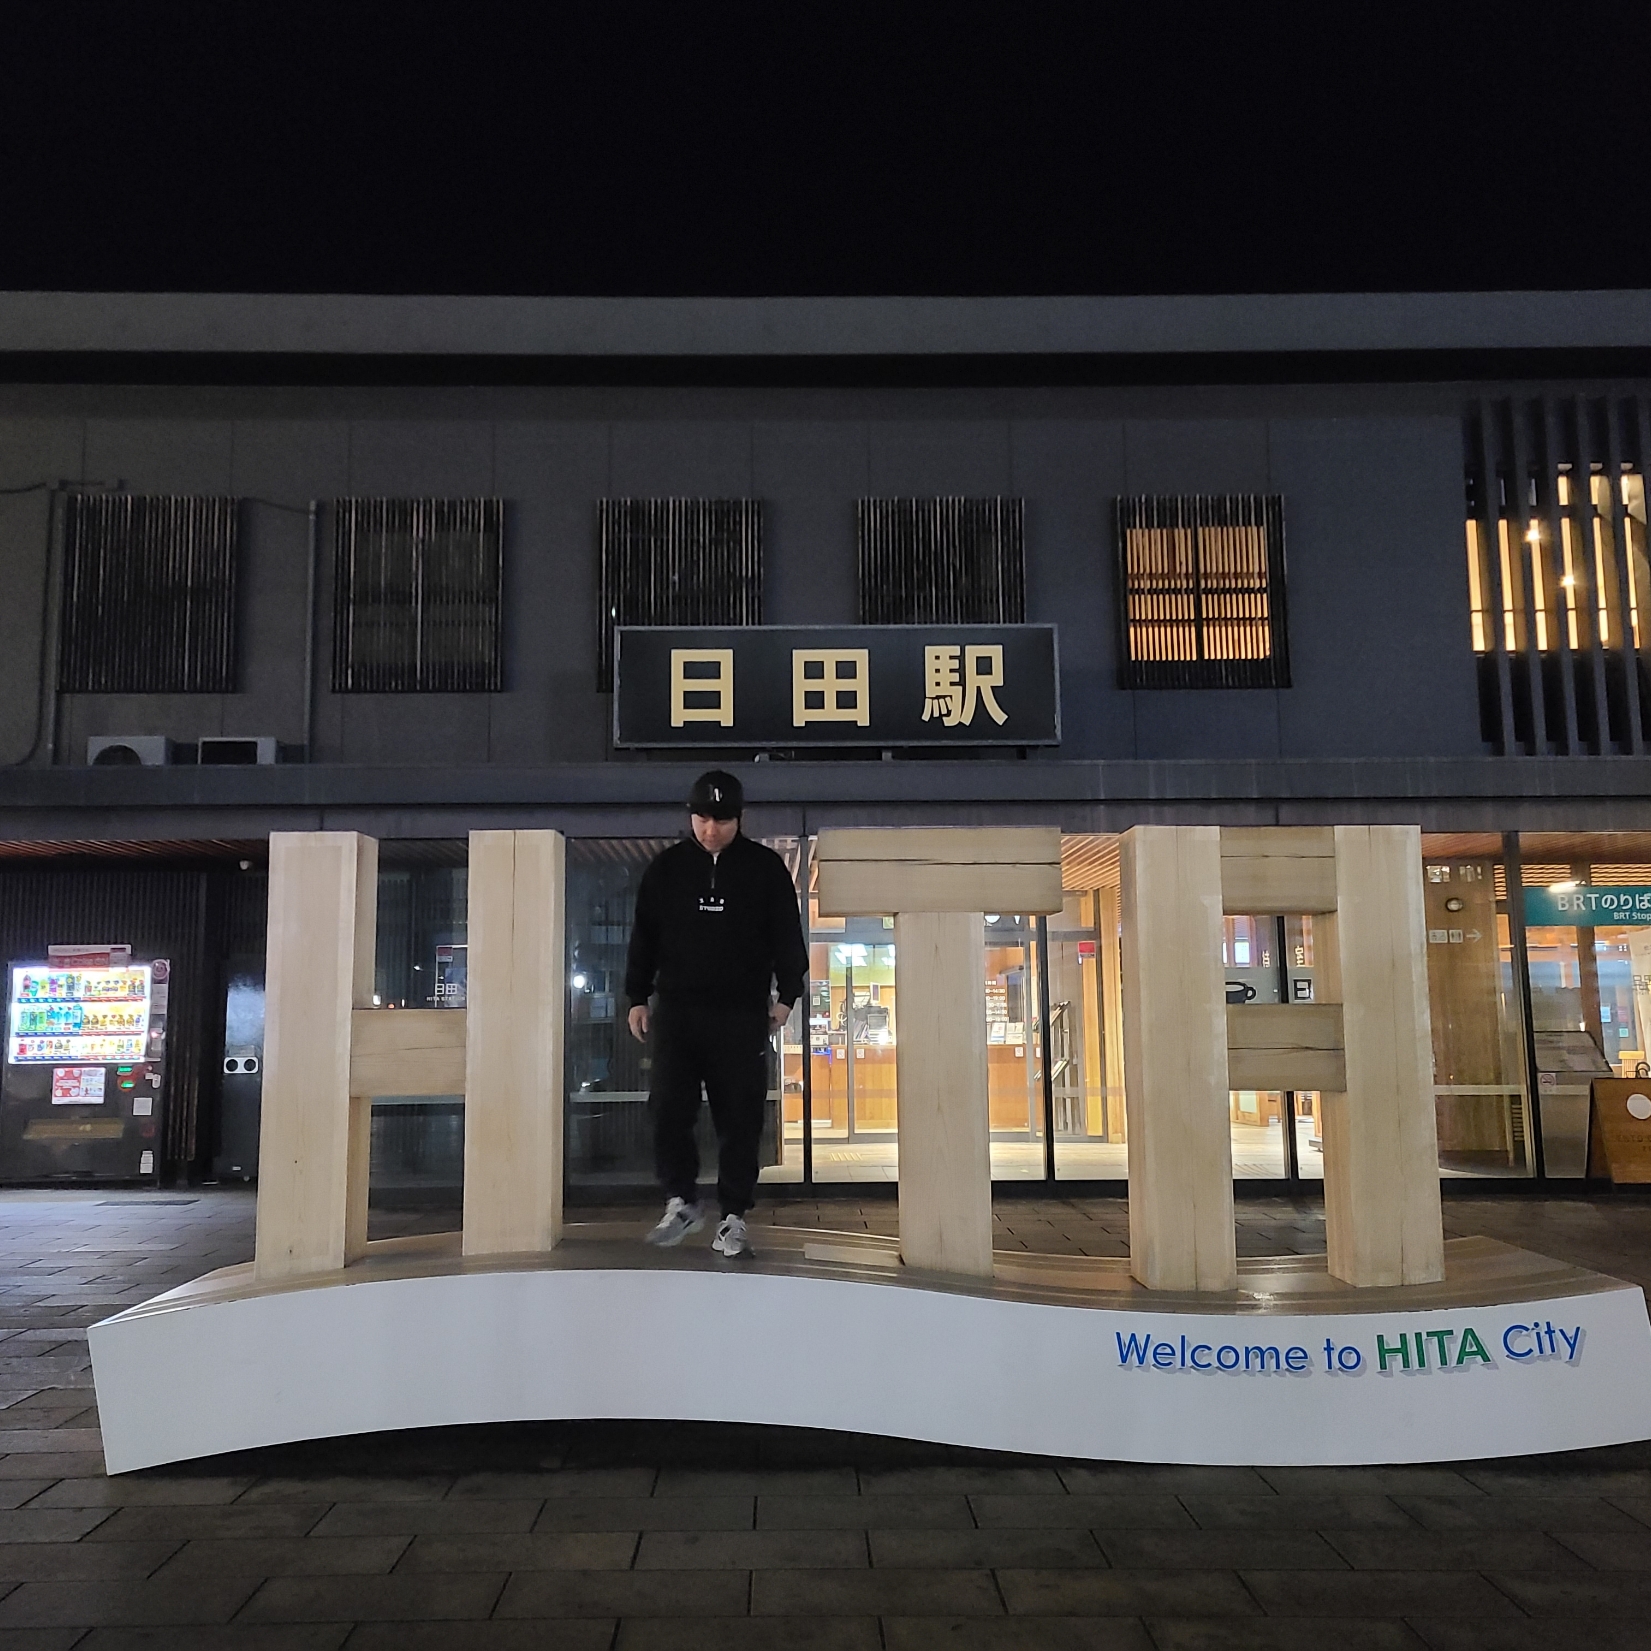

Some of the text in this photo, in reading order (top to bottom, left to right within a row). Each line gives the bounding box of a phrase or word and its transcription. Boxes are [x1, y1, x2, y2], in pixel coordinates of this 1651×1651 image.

[670, 644, 1009, 727] 日田駅
[1613, 912, 1651, 921] BRT Stop
[1115, 1320, 1582, 1373] Welcome to HITA City
